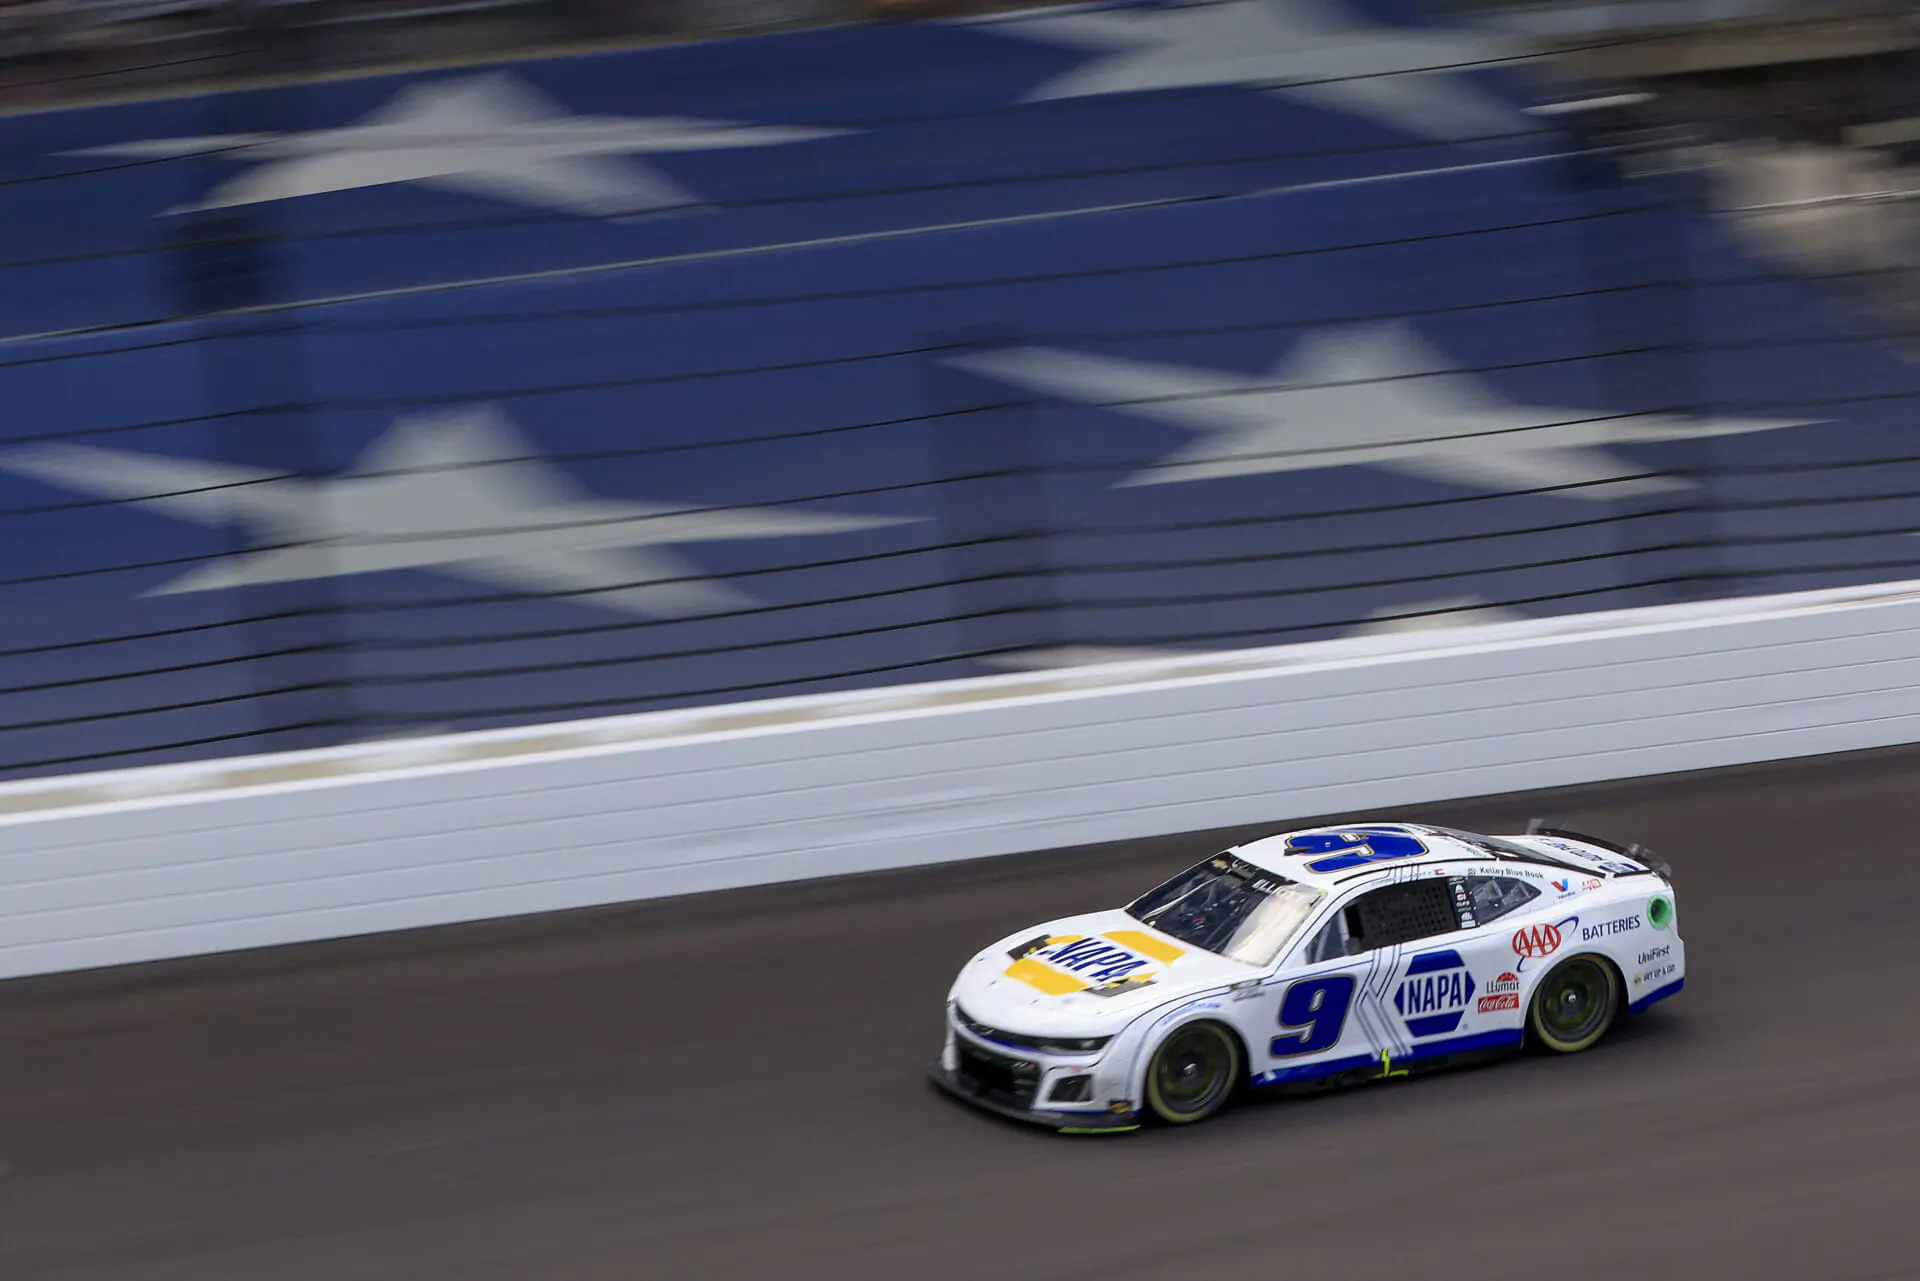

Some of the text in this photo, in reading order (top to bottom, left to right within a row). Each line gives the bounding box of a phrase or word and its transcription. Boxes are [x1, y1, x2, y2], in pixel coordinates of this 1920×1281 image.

[1480, 867, 1544, 879] Kelley Blue Book
[1515, 923, 1557, 957] AAA
[1582, 915, 1640, 941] BATTERIES
[1037, 937, 1149, 982] NAPA
[1638, 944, 1670, 965] UniFirst
[1408, 971, 1462, 1015] NAPA
[1269, 973, 1356, 1059] 9
